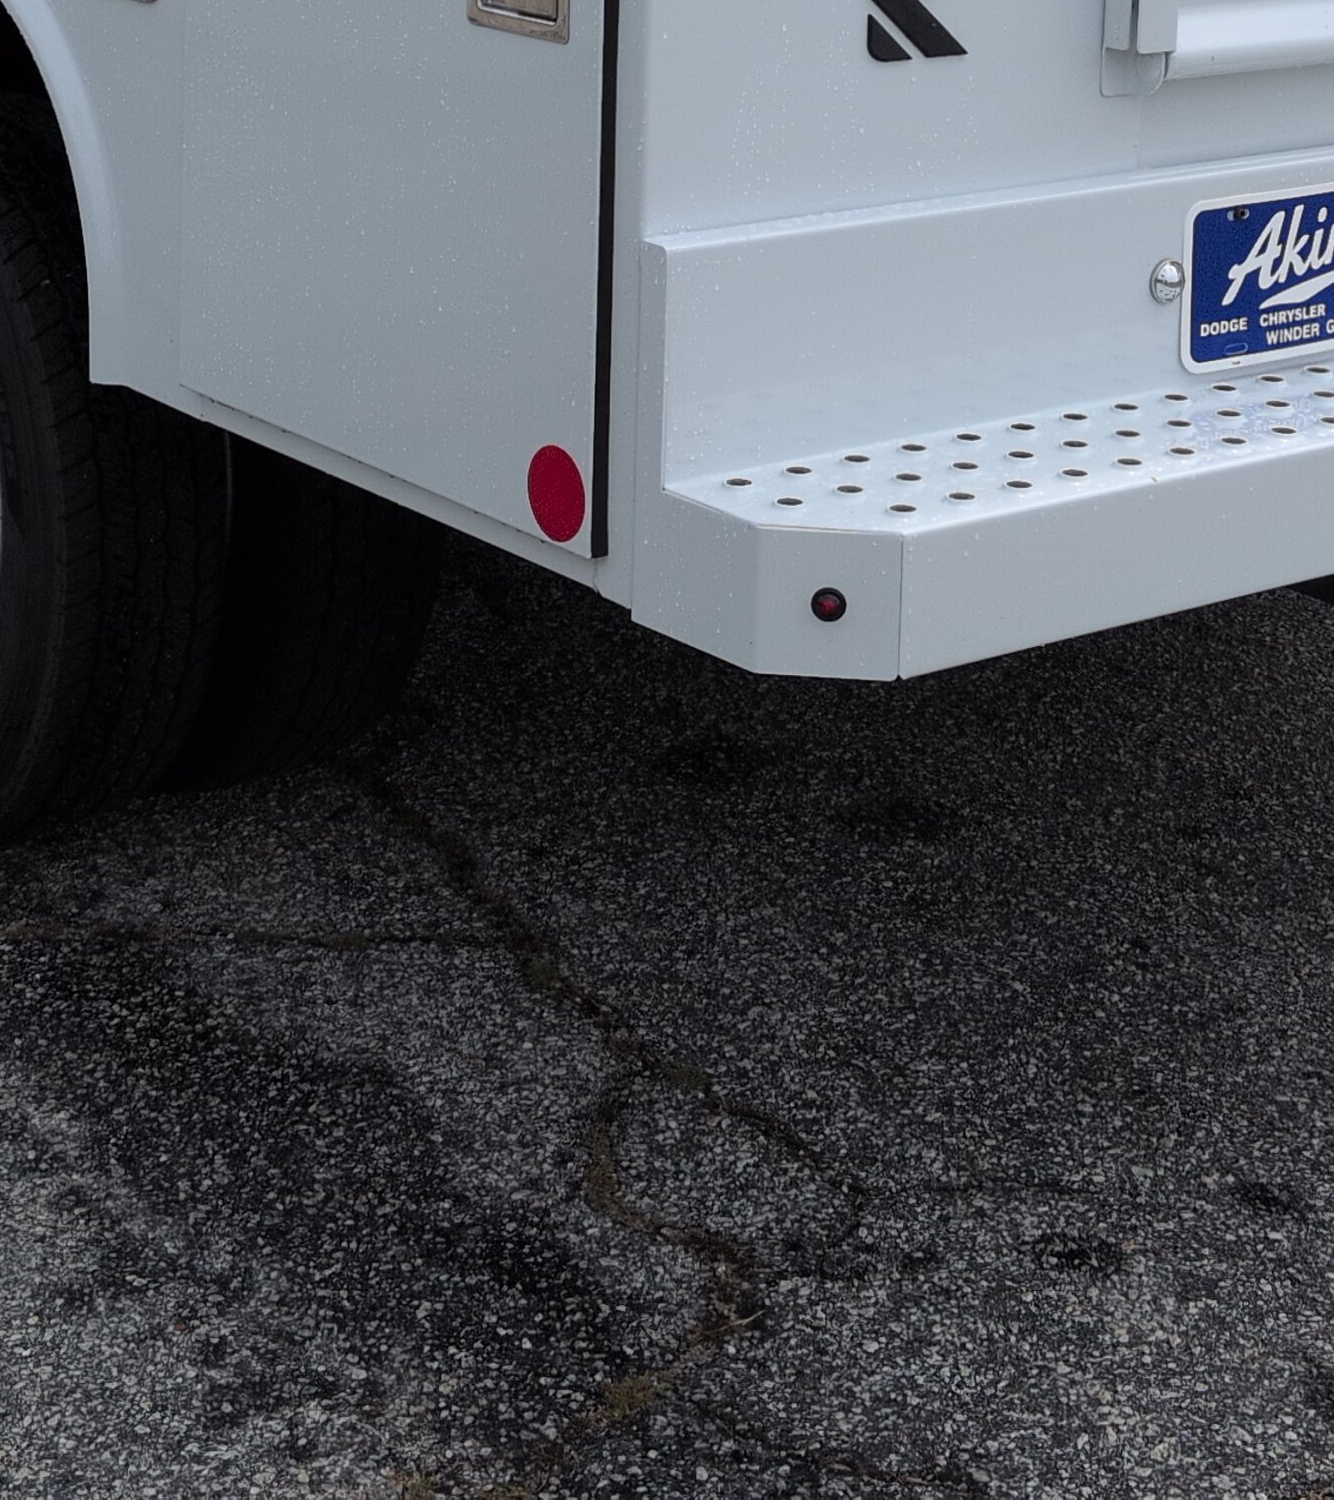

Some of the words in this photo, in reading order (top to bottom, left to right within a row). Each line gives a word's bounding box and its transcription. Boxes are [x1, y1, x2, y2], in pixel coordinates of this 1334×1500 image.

[1200, 318, 1247, 337] DODGE
[1259, 304, 1325, 327] CHRYSLER
[1267, 324, 1319, 345] WINDER
